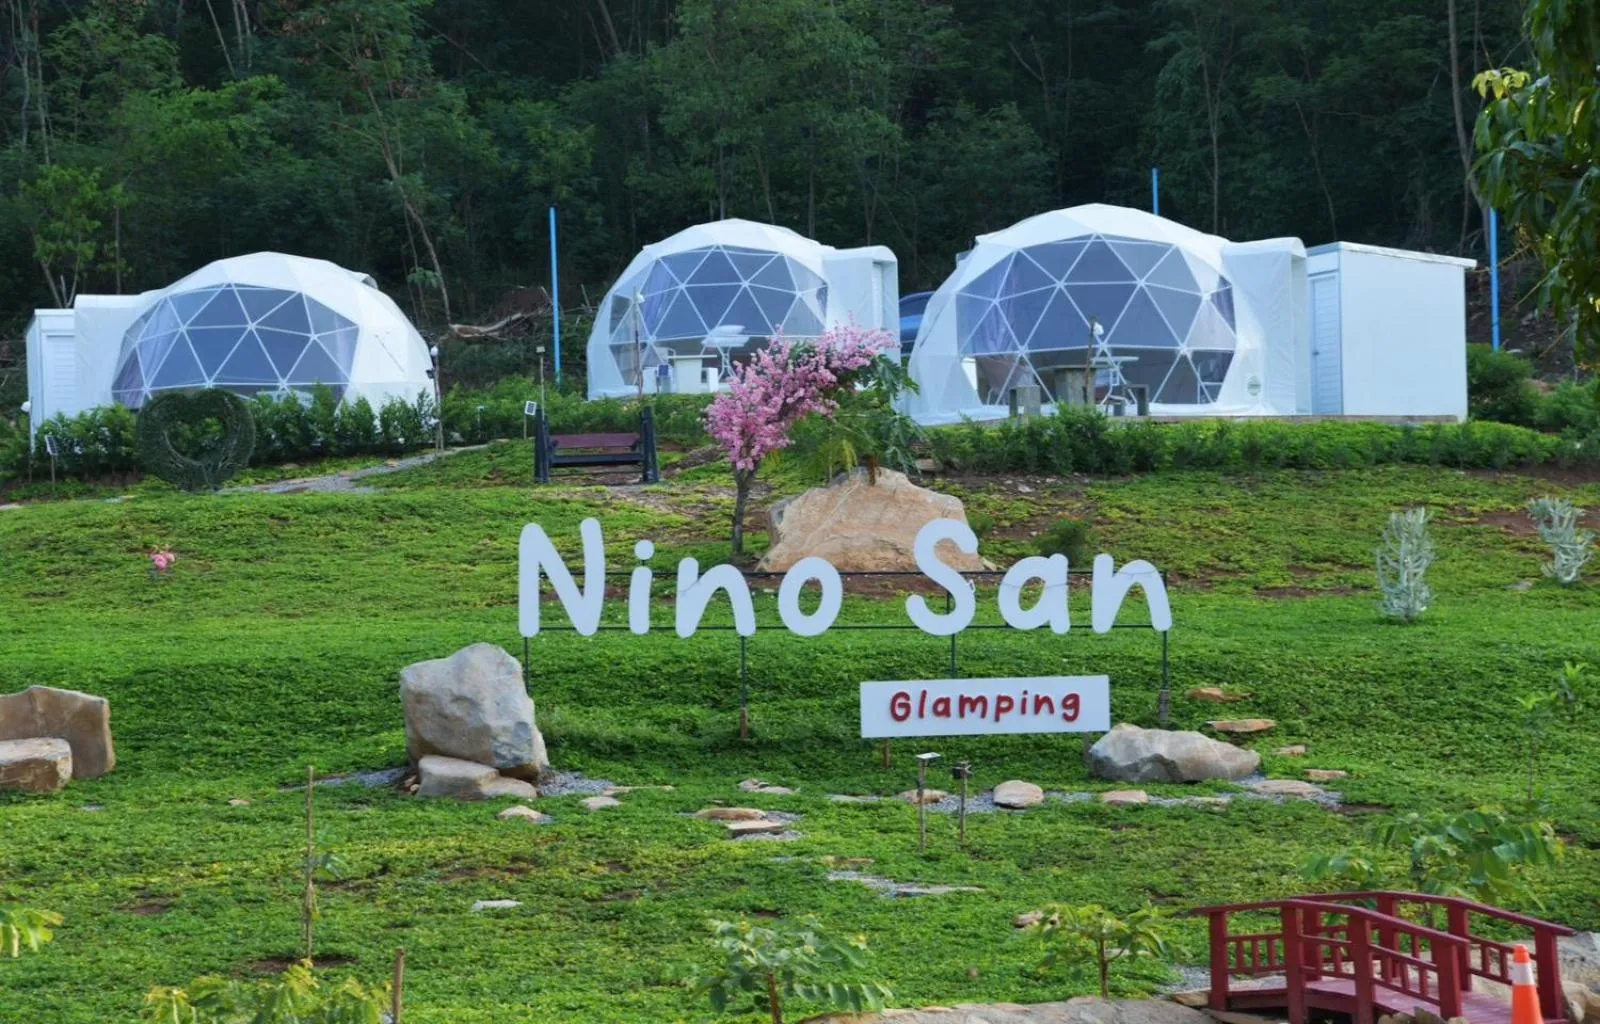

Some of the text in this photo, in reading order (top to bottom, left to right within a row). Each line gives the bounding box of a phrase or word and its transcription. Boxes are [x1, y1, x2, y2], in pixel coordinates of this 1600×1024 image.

[519, 517, 1172, 637] Nino San
[890, 690, 1081, 722] Glamping
